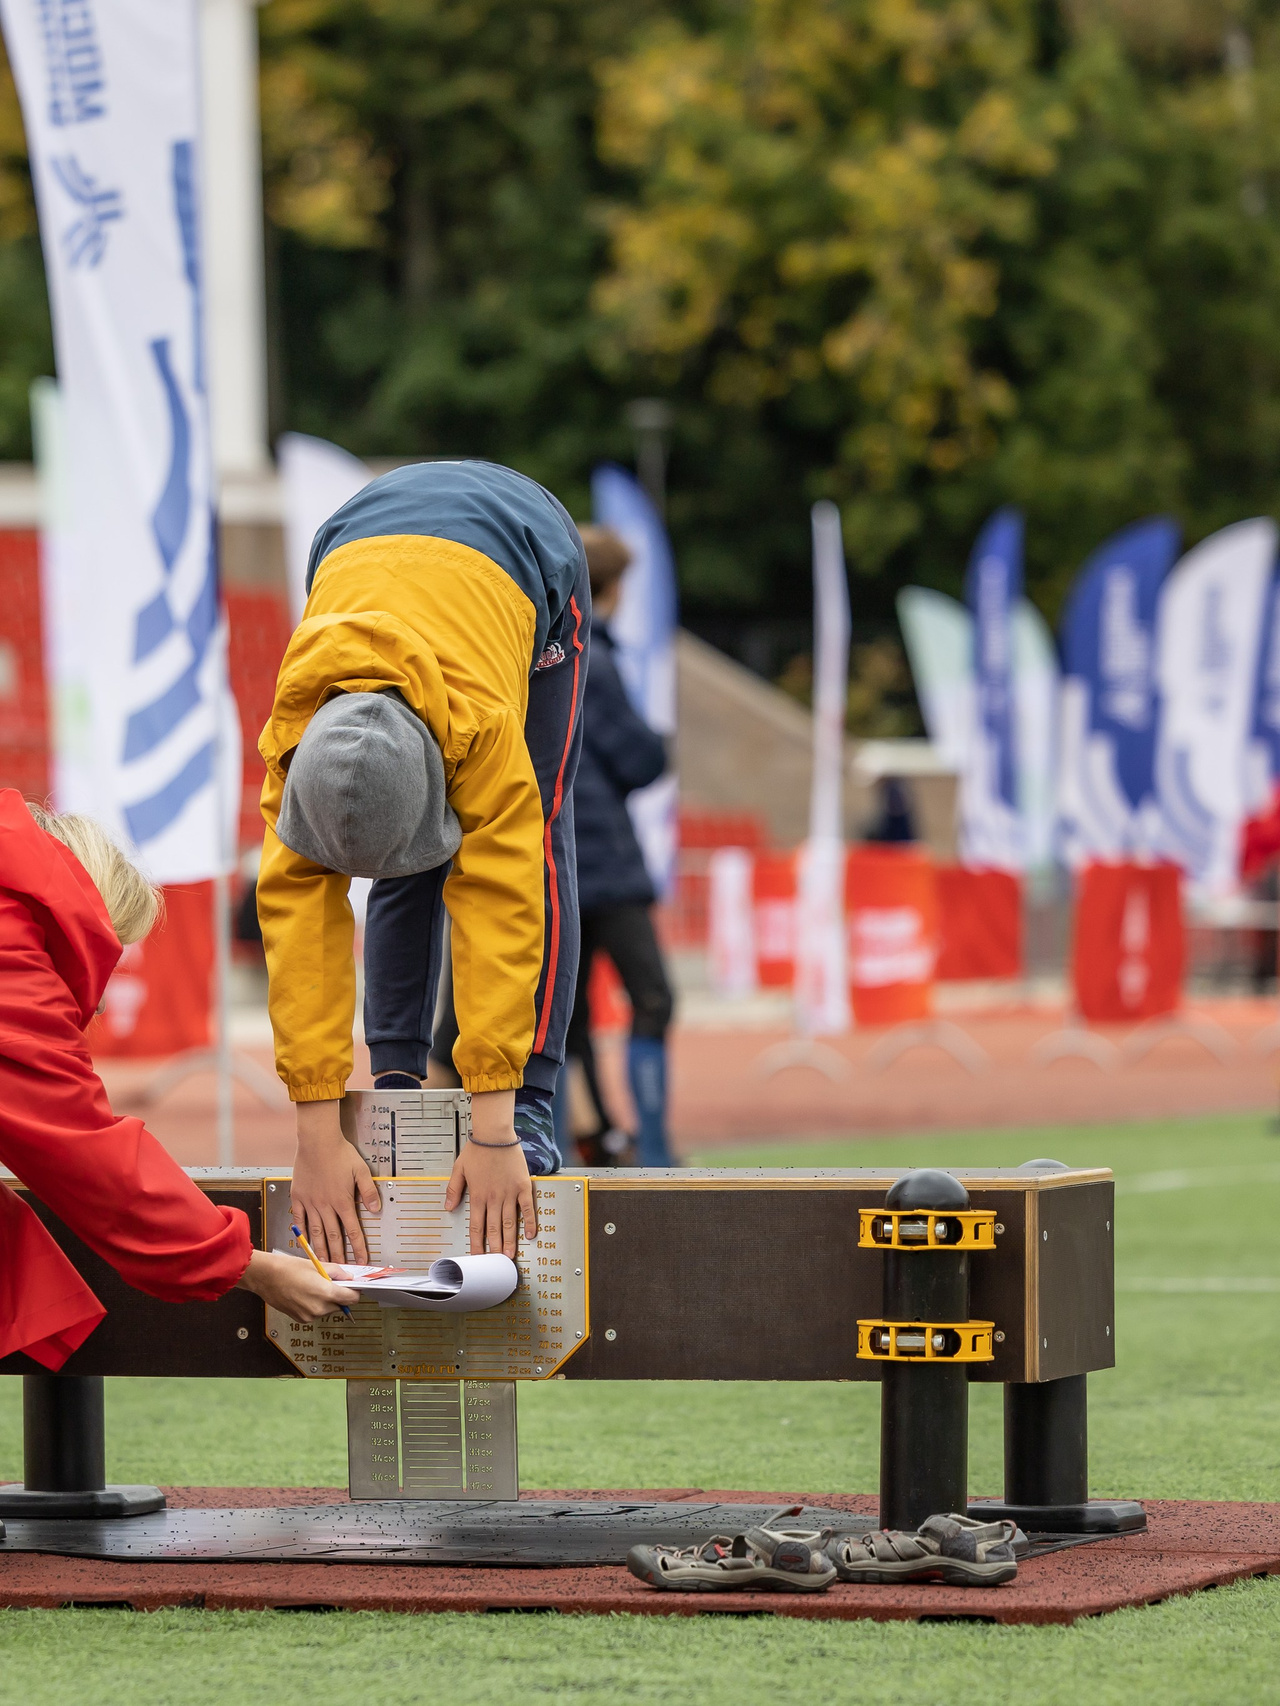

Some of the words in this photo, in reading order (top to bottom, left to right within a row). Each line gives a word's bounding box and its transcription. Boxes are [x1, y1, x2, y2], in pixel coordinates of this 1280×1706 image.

[537, 1274, 548, 1282] 12
[321, 1332, 330, 1340] 19
[291, 1339, 301, 1347] 20
[322, 1348, 331, 1356] 21
[294, 1354, 305, 1362] 22
[322, 1364, 332, 1372] 23
[398, 1363, 455, 1376] sogto.ru
